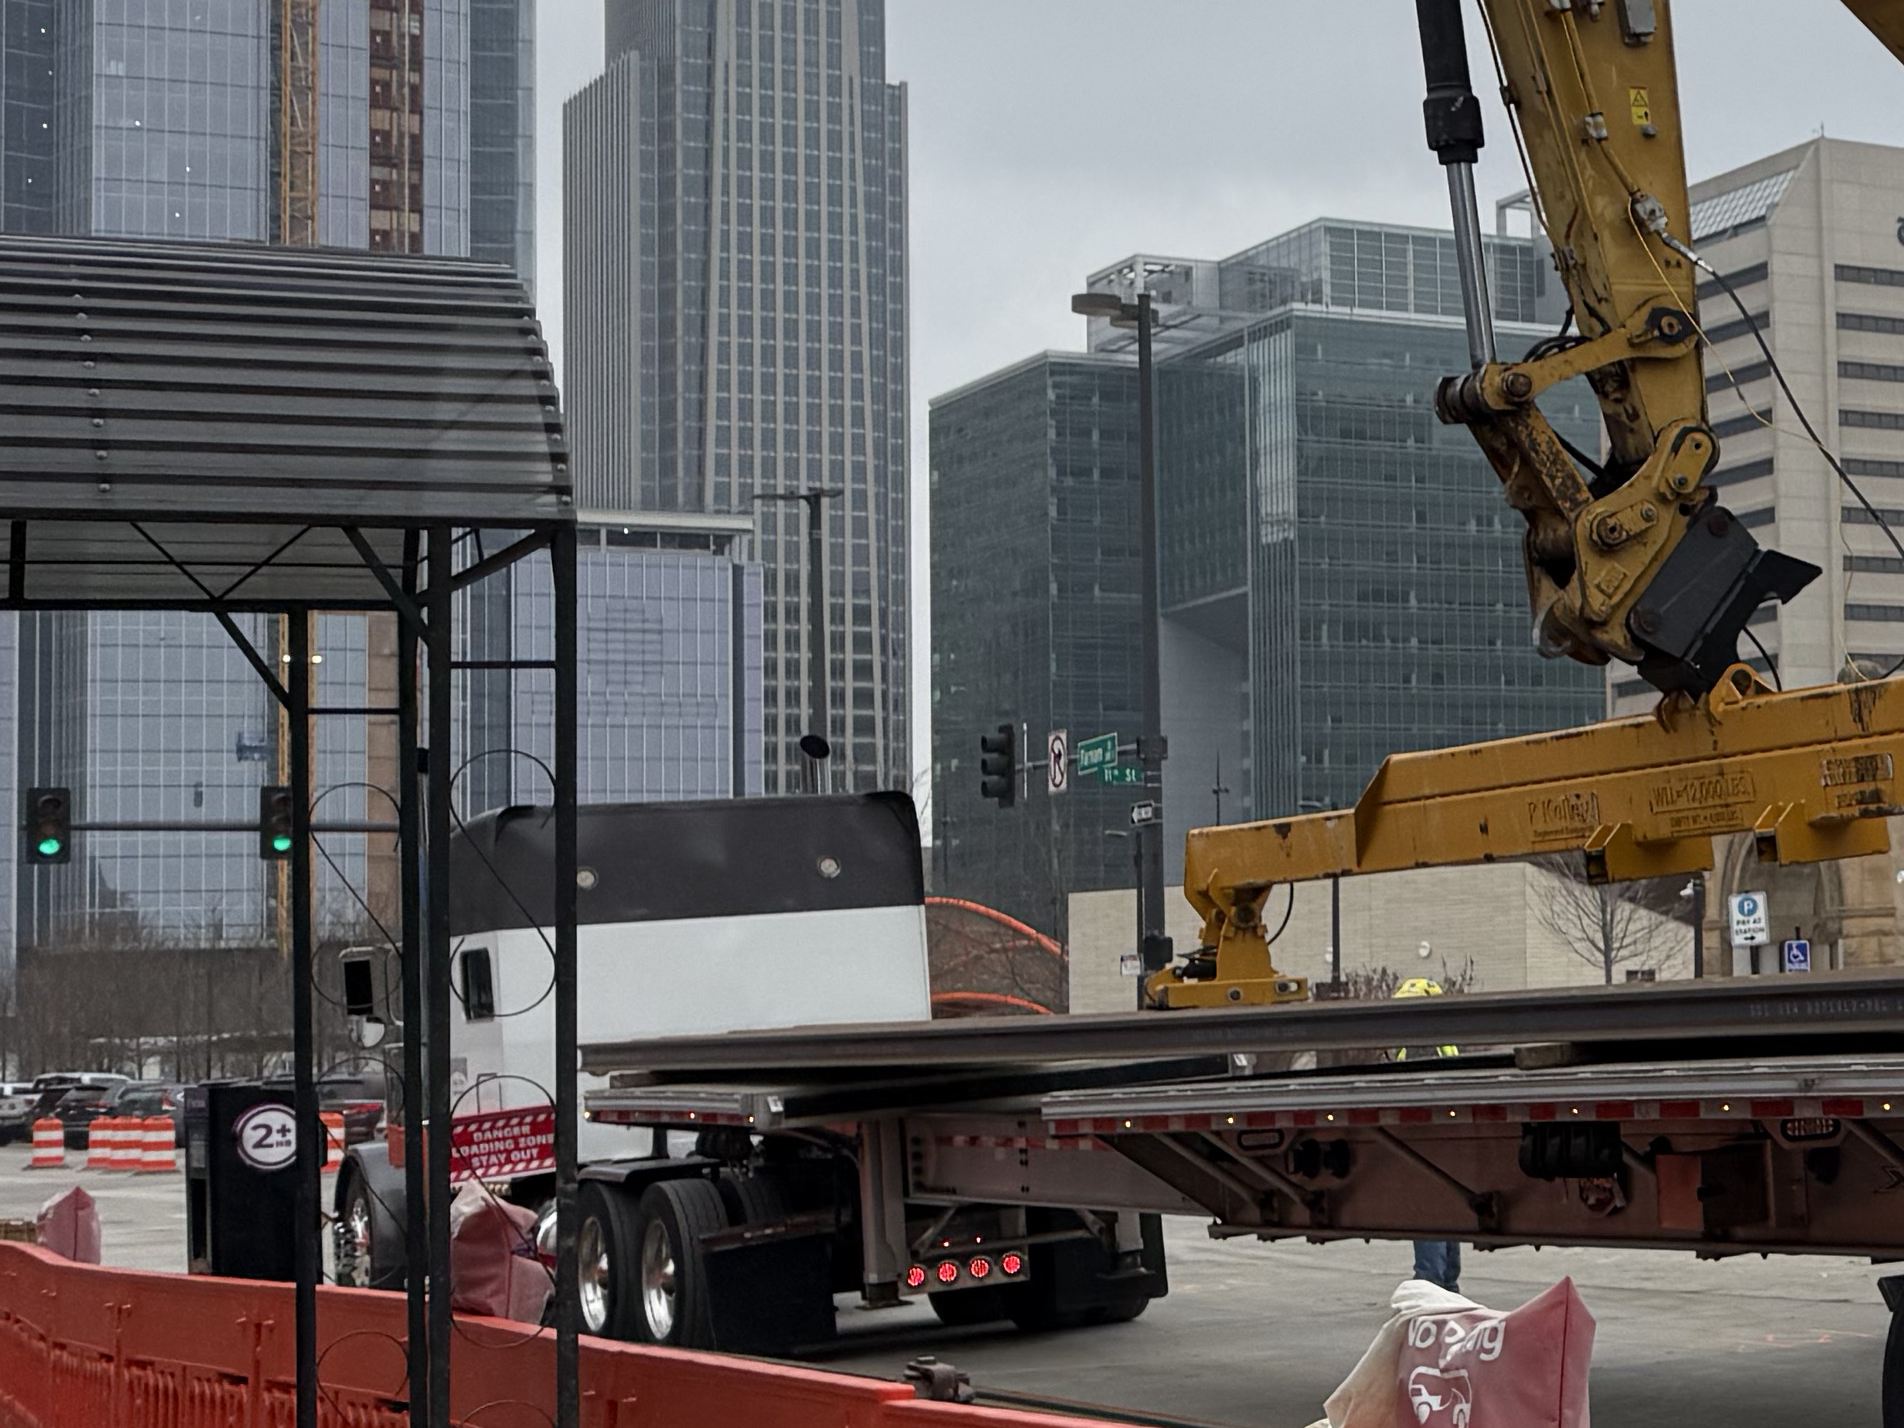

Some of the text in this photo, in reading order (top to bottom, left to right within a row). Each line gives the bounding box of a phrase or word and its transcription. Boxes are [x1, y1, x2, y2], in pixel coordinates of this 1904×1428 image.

[473, 1125, 531, 1143] DANGER
[471, 1148, 539, 1169] STAY OUT
